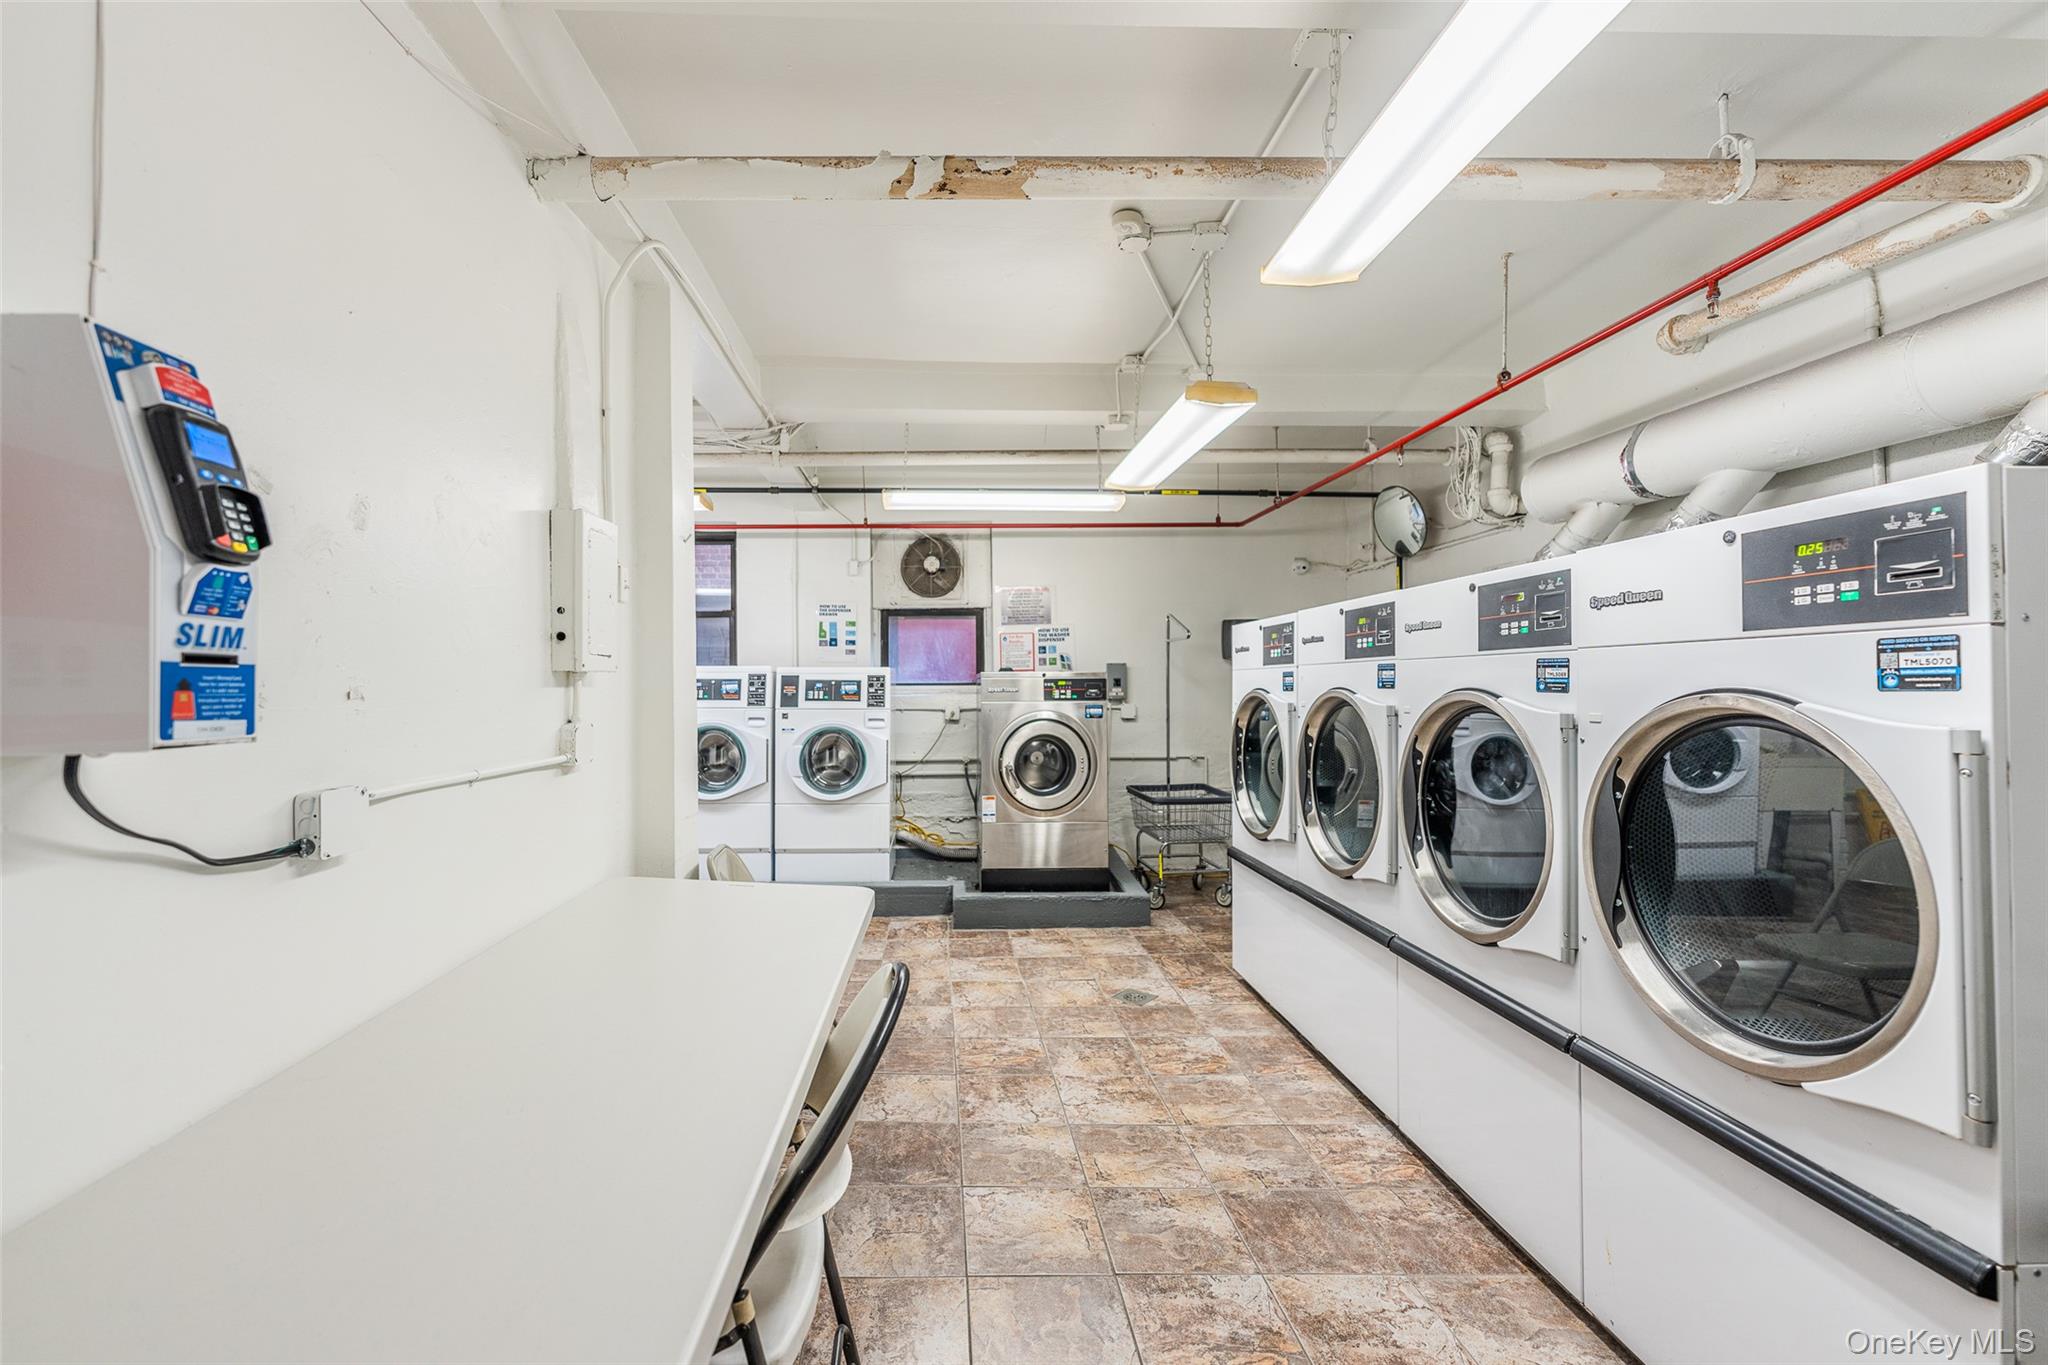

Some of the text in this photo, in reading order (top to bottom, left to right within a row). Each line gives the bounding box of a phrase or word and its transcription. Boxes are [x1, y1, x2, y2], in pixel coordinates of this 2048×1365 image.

[1590, 589, 1663, 610] Speed Queen
[176, 622, 244, 649] SLIM
[1904, 657, 1953, 666] TML5070
